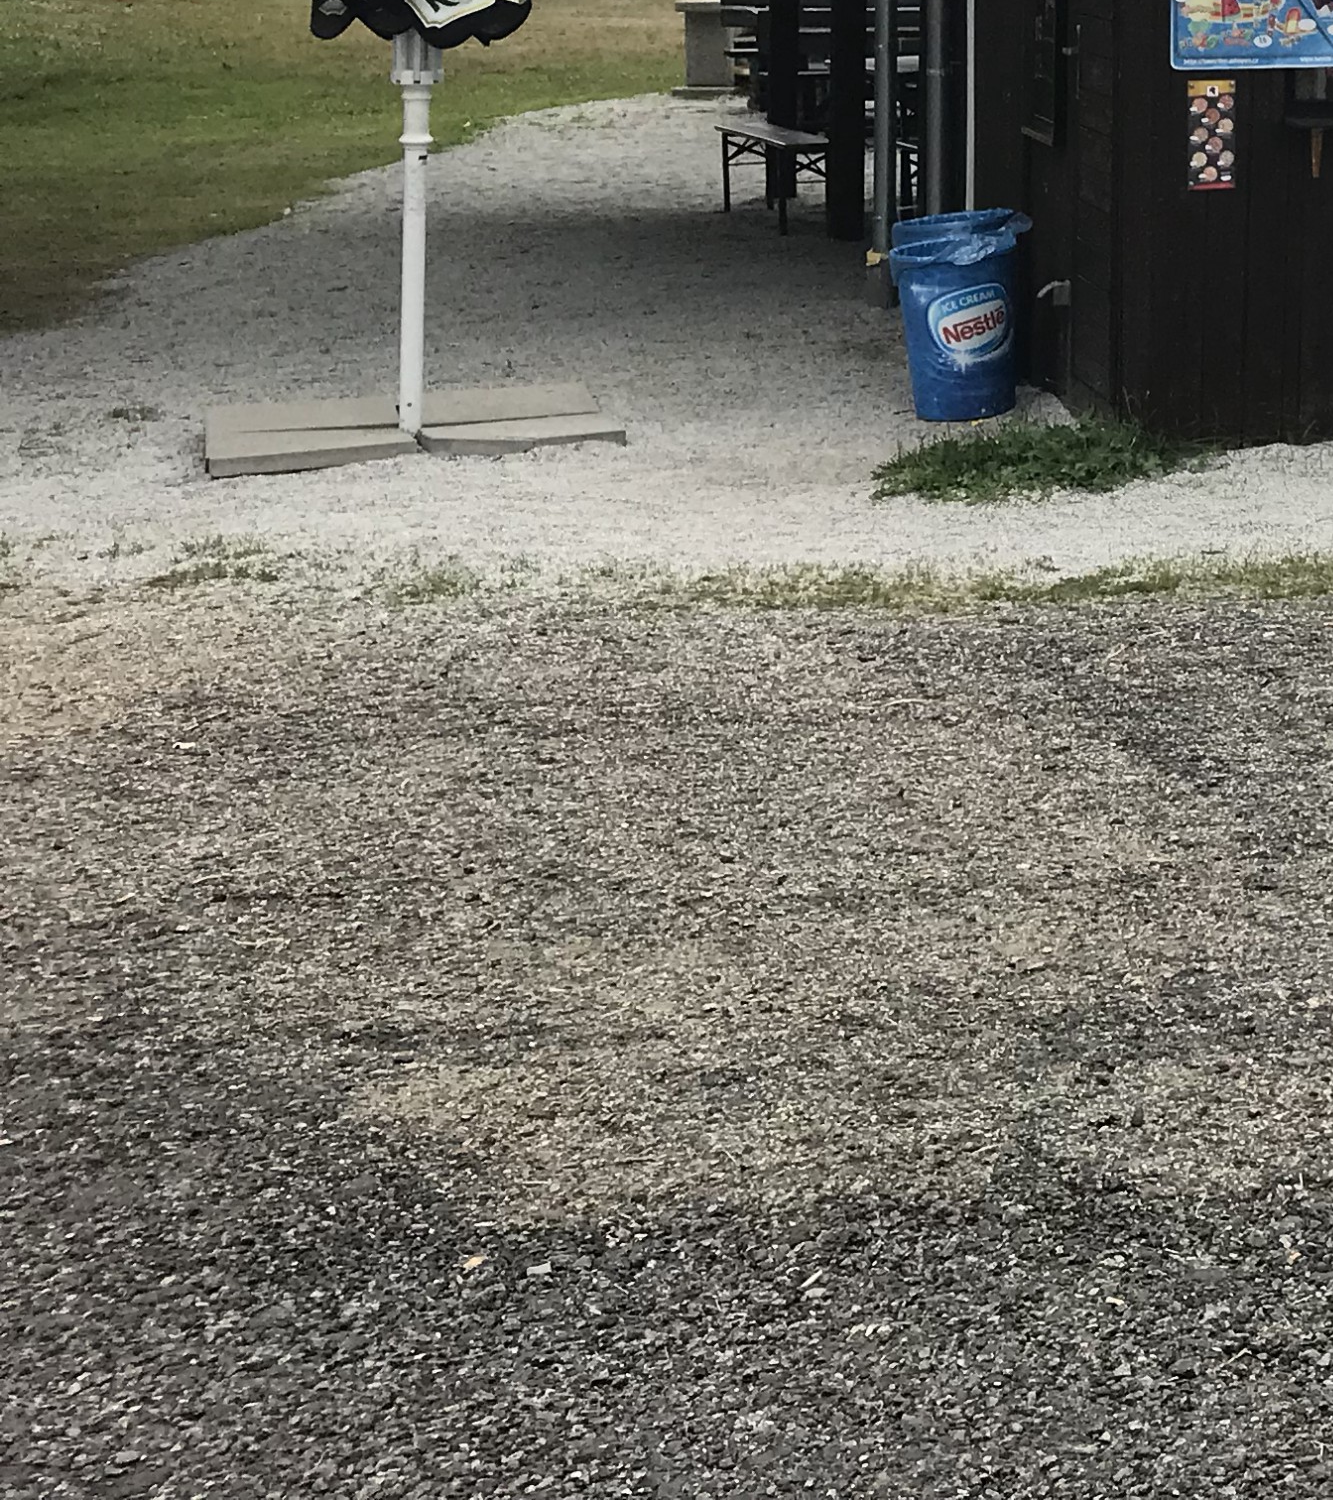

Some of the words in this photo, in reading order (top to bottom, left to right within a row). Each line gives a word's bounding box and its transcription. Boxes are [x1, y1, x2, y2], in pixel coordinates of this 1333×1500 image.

[941, 299, 959, 314] ICE
[959, 289, 996, 308] CREAM
[942, 307, 1006, 345] Nestlé
